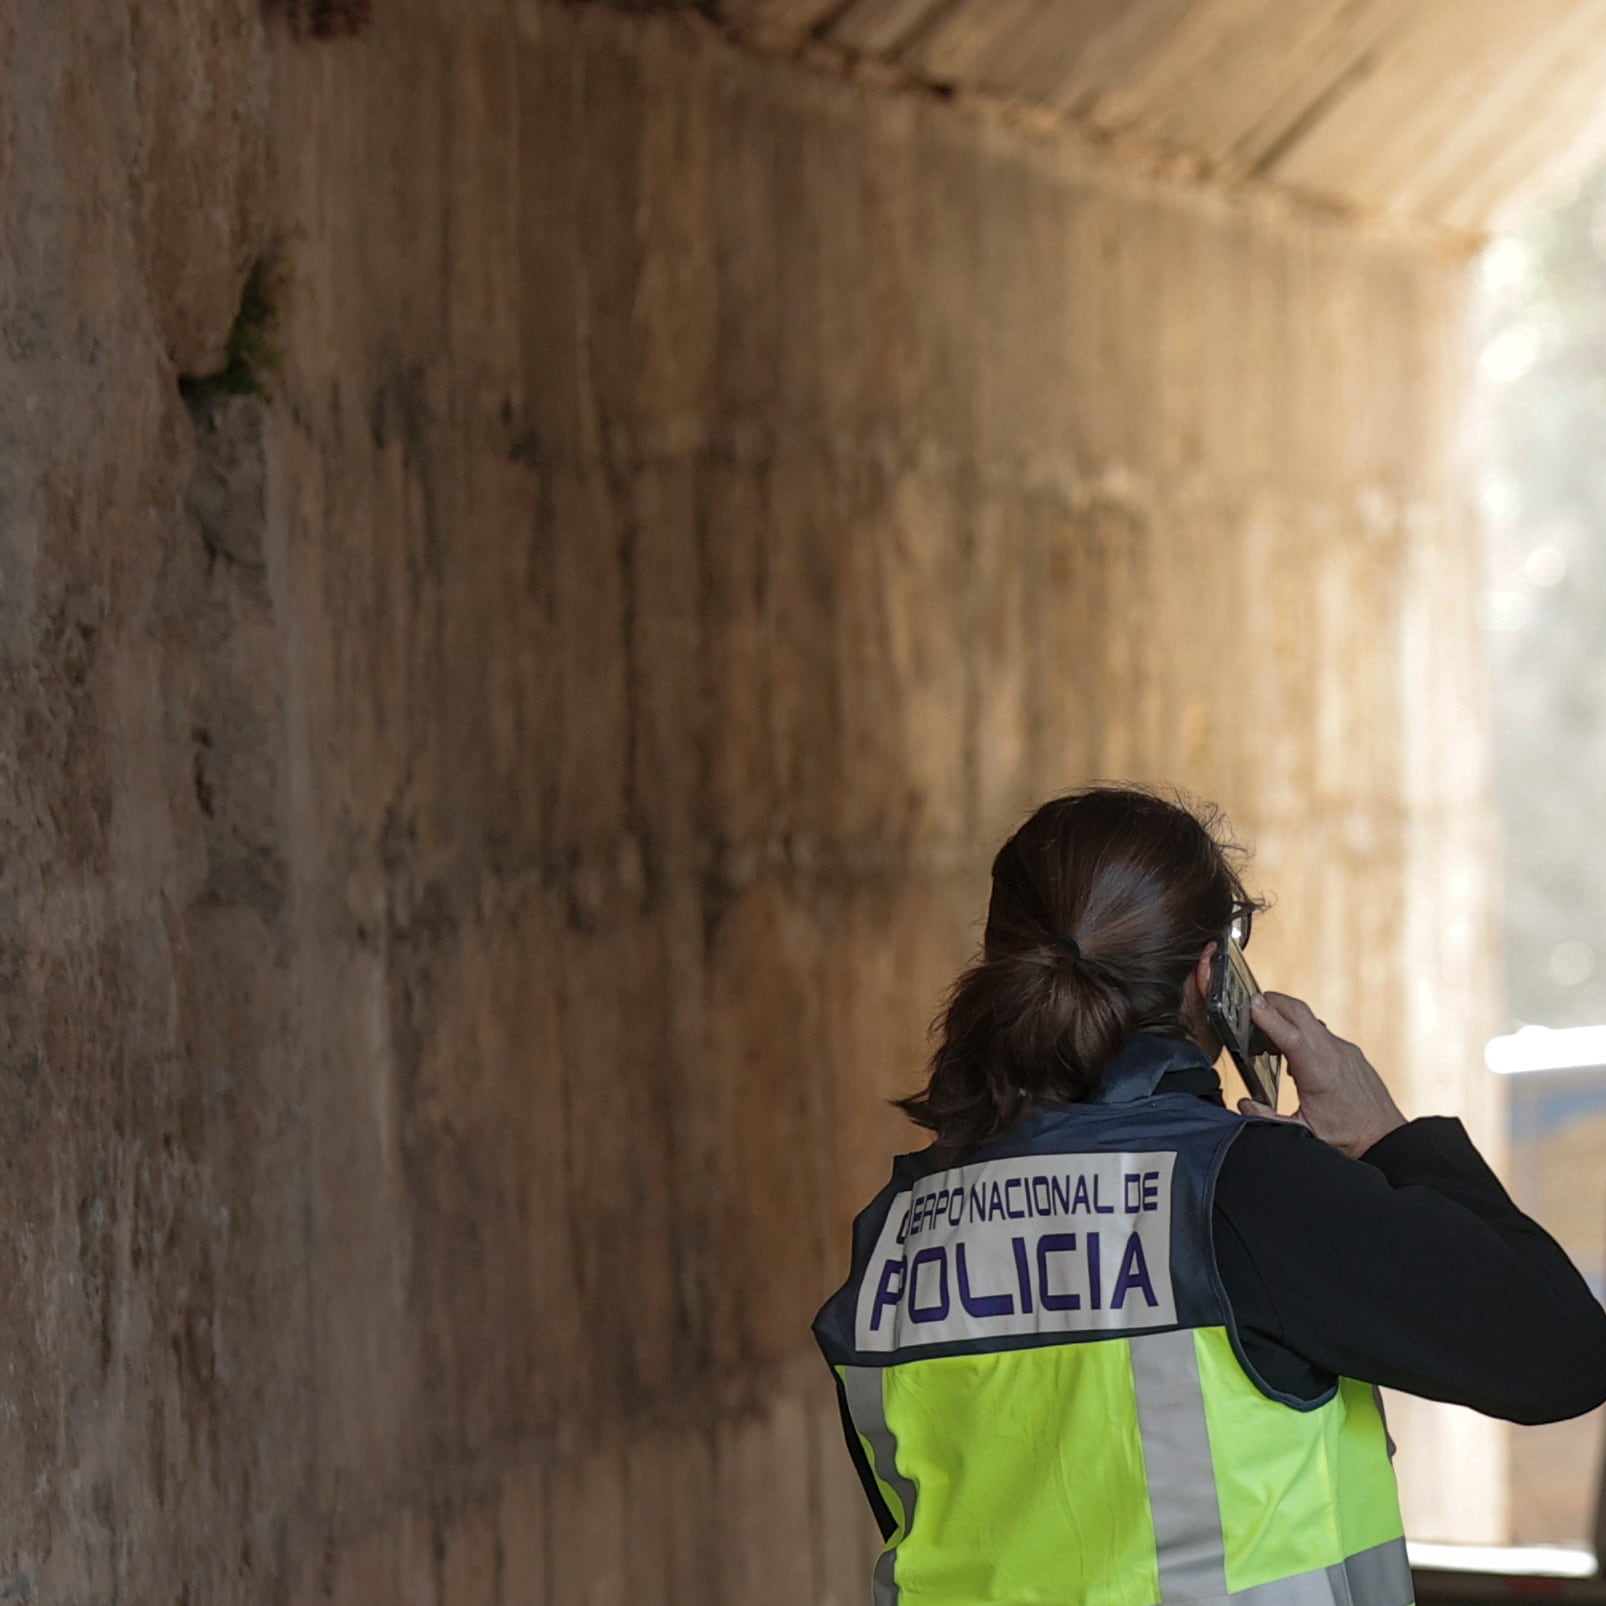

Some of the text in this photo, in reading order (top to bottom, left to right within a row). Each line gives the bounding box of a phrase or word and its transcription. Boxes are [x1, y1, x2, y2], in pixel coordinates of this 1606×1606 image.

[968, 1173, 1114, 1224] NACIONAL
[1124, 1171, 1160, 1214] DE
[869, 1231, 1159, 1332] POLICIA
